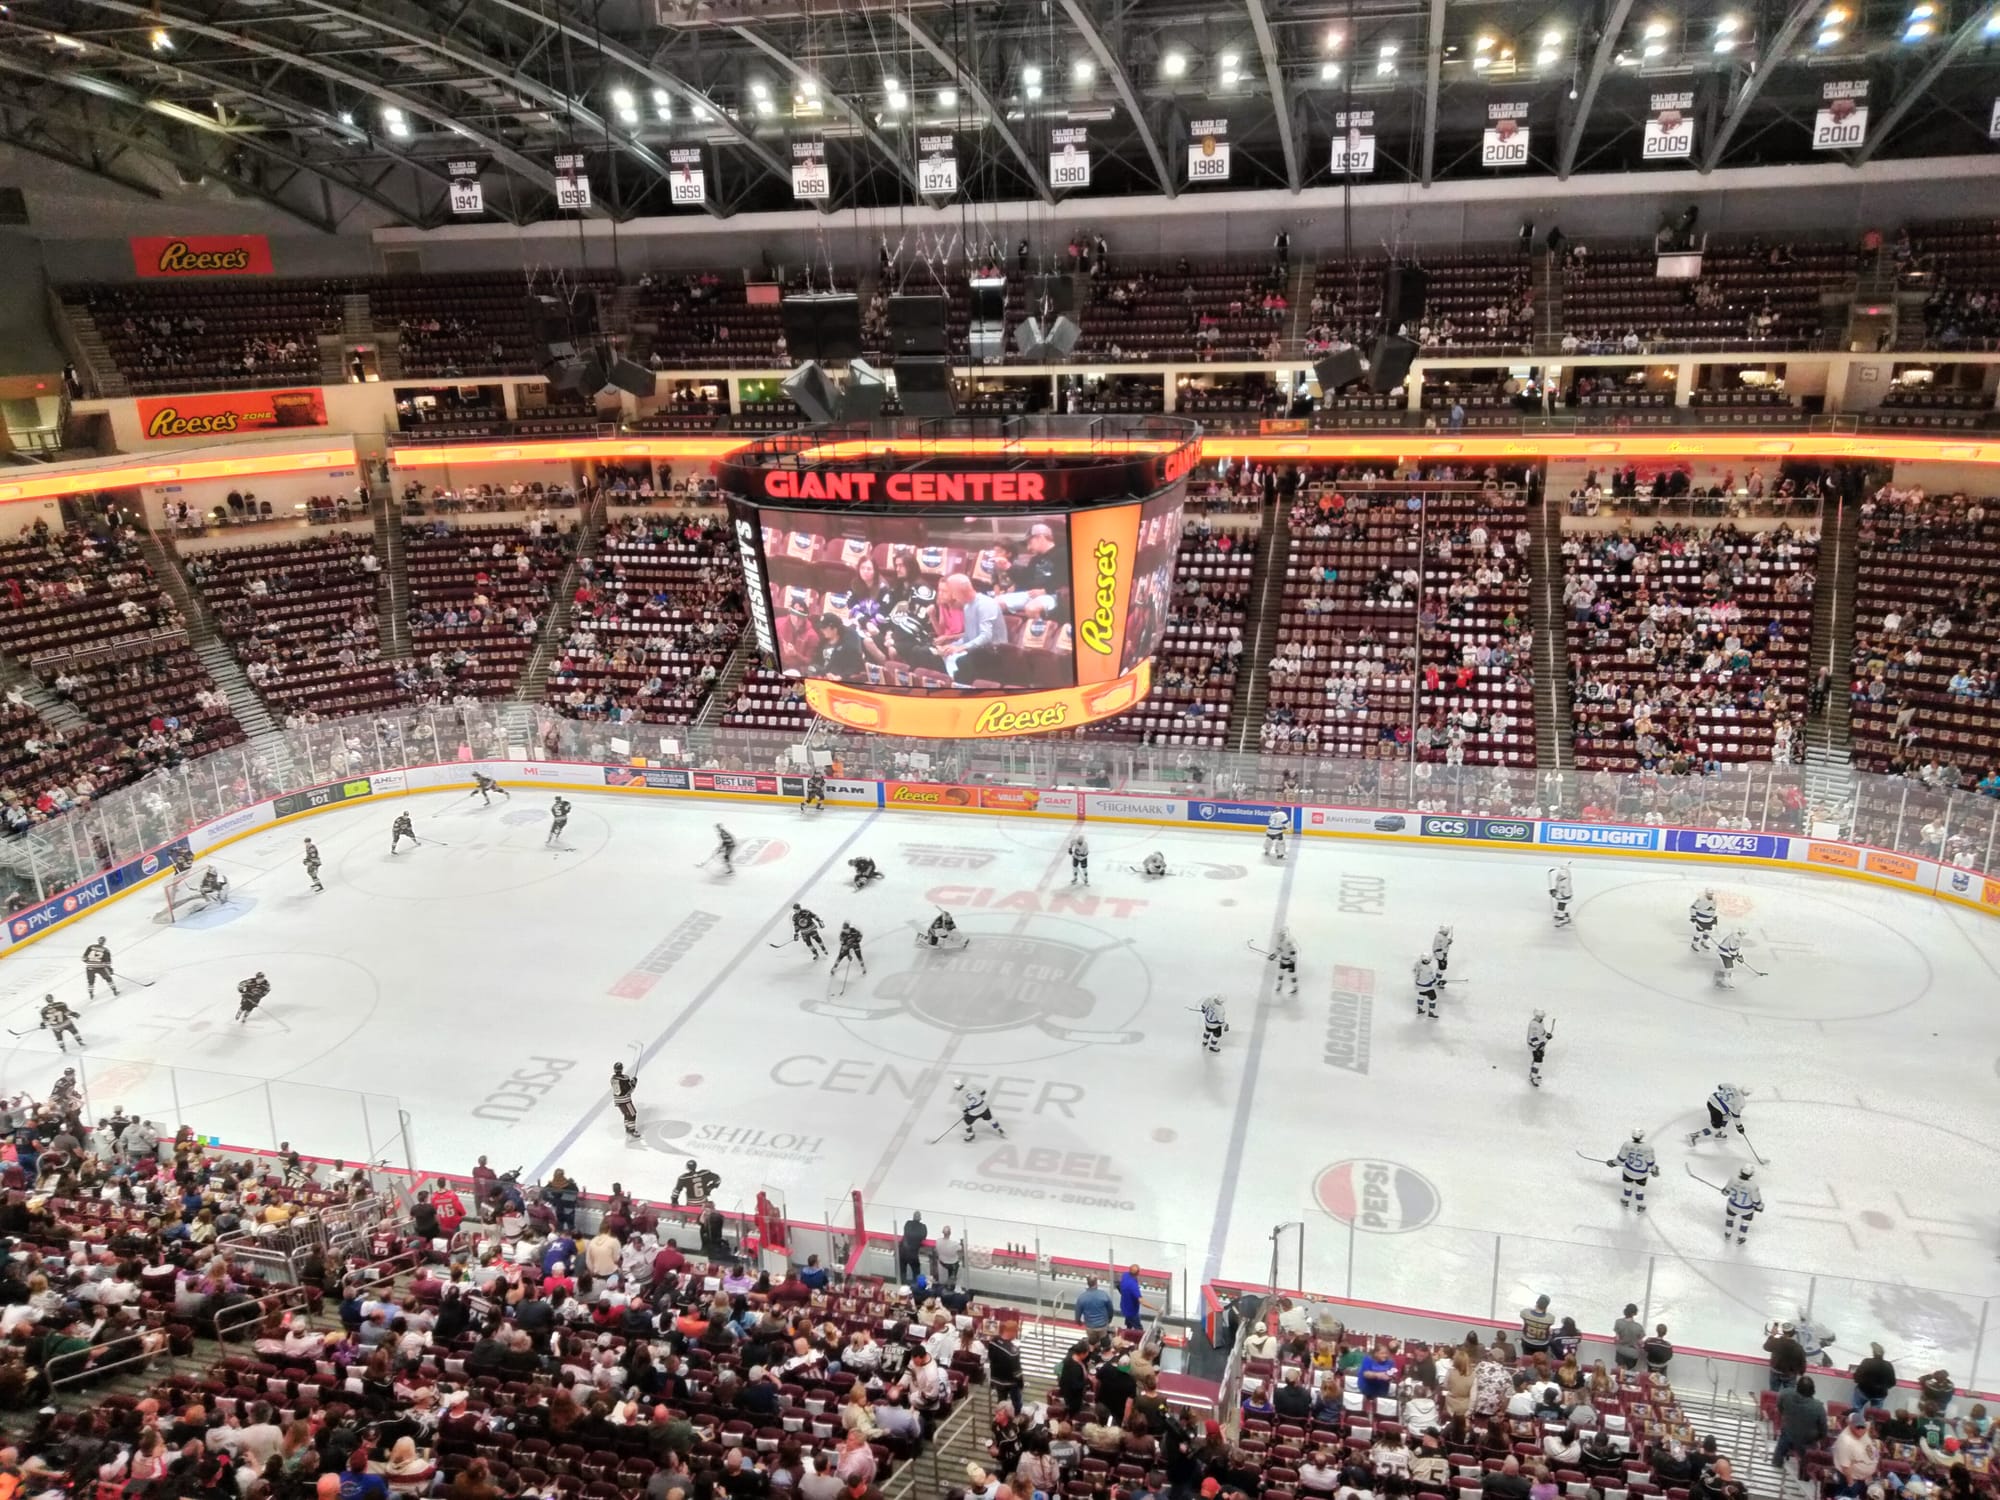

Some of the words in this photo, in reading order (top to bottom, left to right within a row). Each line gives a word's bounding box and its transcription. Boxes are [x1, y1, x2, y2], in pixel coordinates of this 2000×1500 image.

[1818, 125, 1861, 143] 2010
[1485, 144, 1525, 160] 2006
[1646, 136, 1688, 153] 2009
[1192, 159, 1225, 175] 1988
[1335, 152, 1369, 168] 1997
[924, 174, 953, 189] 1974
[1054, 167, 1085, 182] 1980
[674, 185, 701, 199] 1959
[796, 179, 825, 193] 1969
[454, 195, 478, 209] 1947
[159, 241, 249, 272] Reese's
[148, 408, 239, 438] Reese's
[242, 412, 273, 421] ZONE
[764, 471, 876, 500] GIANT
[886, 472, 1046, 502] CENTER
[735, 518, 774, 655] HERSHEY'S
[1081, 538, 1119, 656] Reese's
[976, 701, 1068, 734] Reese's
[715, 776, 737, 786] BEST
[737, 777, 756, 788] LINE
[826, 785, 865, 794] RAM
[310, 793, 329, 806] 101
[893, 785, 940, 803] Reese's
[1043, 797, 1073, 806] GIANT
[1101, 802, 1163, 815] HIGHMARK
[1428, 820, 1465, 834] ecs
[1489, 823, 1525, 838] eagle
[1550, 827, 1591, 841] BUD
[1591, 830, 1649, 845] LIGHT
[77, 883, 105, 905] PNC
[924, 884, 1150, 920] GIANT
[1337, 871, 1386, 916] PSECU
[28, 906, 58, 929] PNC
[87, 950, 105, 962] 42
[1021, 963, 1067, 981] CUP
[471, 1055, 579, 1124] PSECU
[768, 1053, 1086, 1120] CENTER
[695, 1123, 825, 1153] SHILOH
[986, 1143, 1124, 1184] ABEL
[694, 1182, 705, 1197] 6
[947, 1178, 1047, 1201] ROOFING
[1060, 1193, 1136, 1212] SIDING
[1362, 1163, 1390, 1229] PEPSI
[436, 1203, 455, 1217] 46
